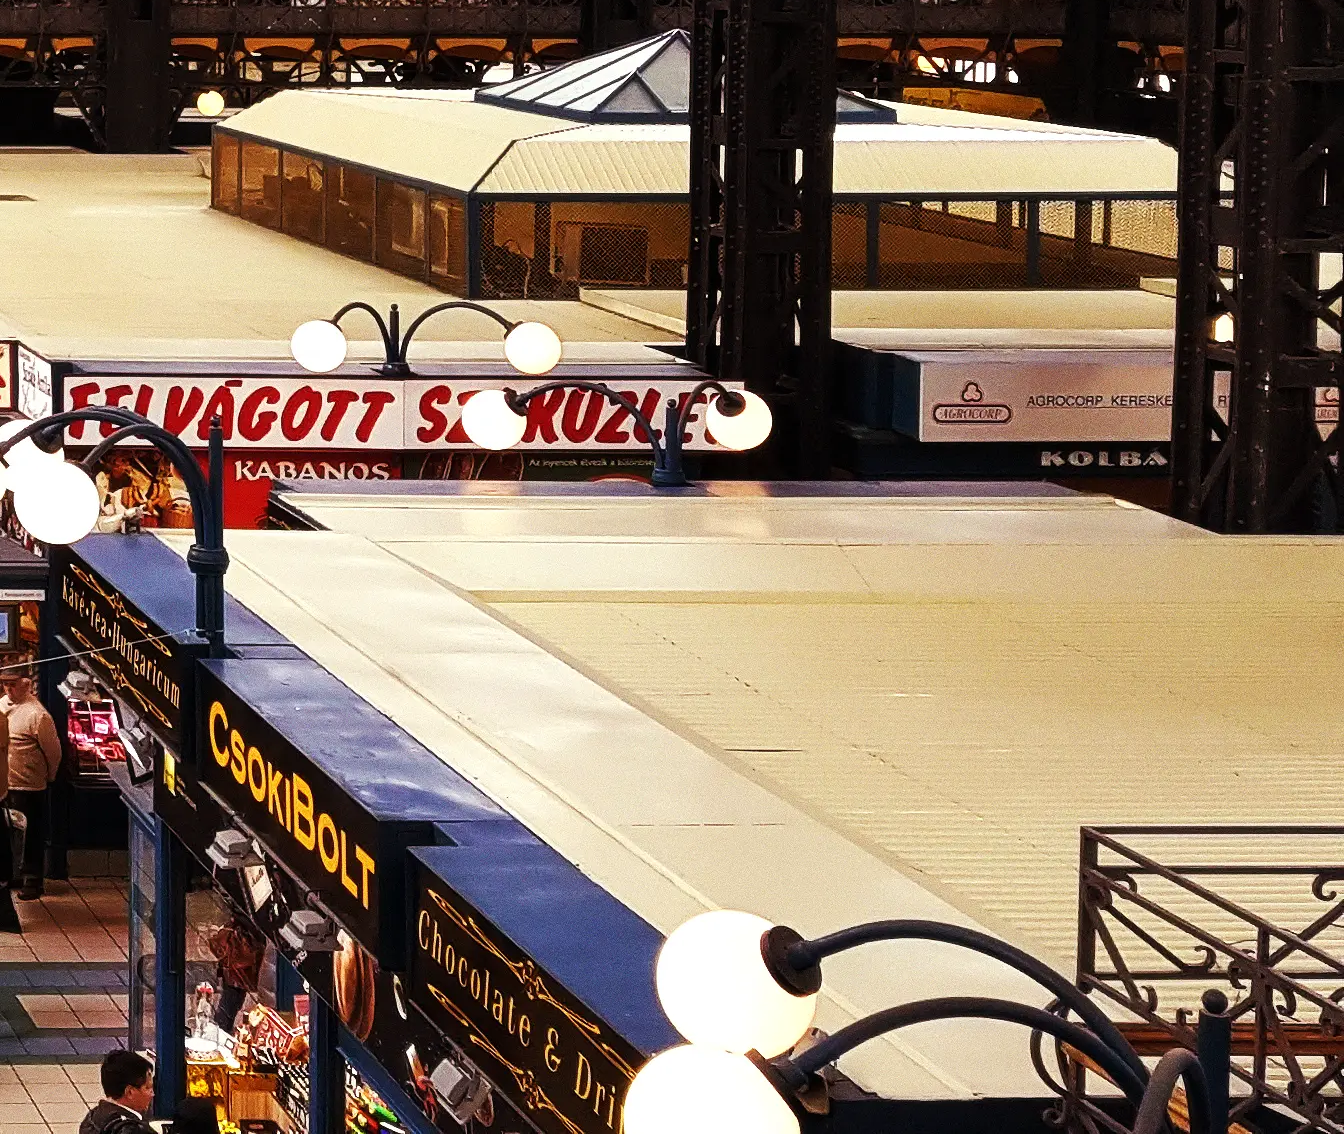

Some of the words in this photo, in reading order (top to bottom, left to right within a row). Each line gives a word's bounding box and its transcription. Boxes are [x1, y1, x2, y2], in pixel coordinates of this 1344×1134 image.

[68, 380, 395, 443] FELVÁGOTT
[234, 460, 390, 481] KABANOS
[418, 909, 531, 1047] Chocolate
[544, 1027, 561, 1072] &
